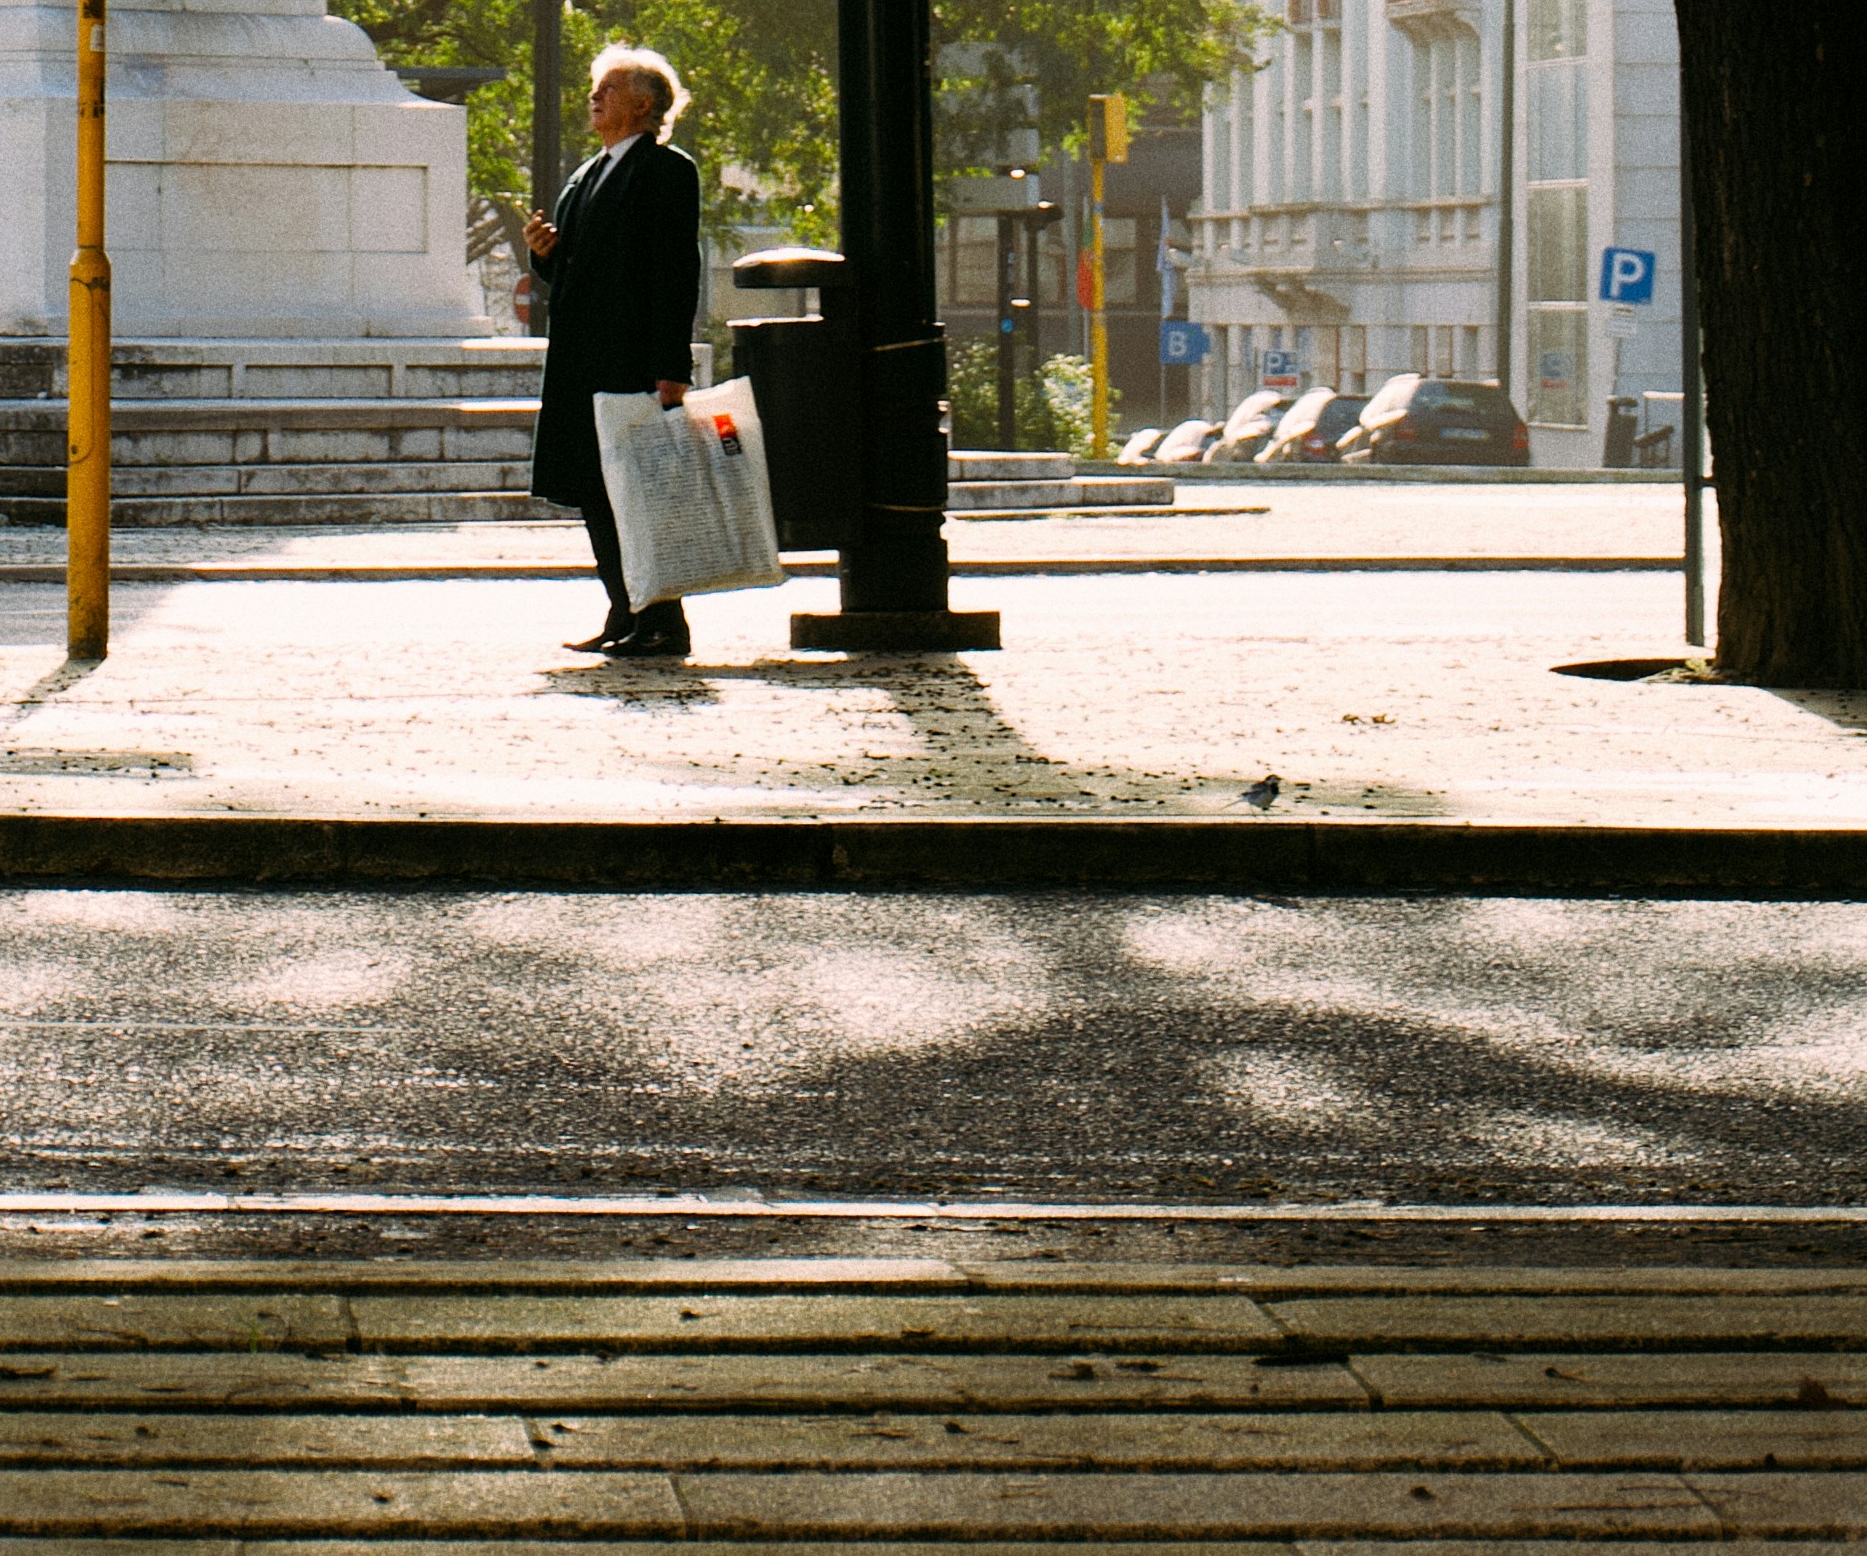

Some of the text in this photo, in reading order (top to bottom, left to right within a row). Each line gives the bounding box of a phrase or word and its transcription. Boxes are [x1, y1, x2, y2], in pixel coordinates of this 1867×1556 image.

[1610, 252, 1645, 298] P
[1168, 330, 1188, 358] B
[1267, 352, 1283, 374] P
